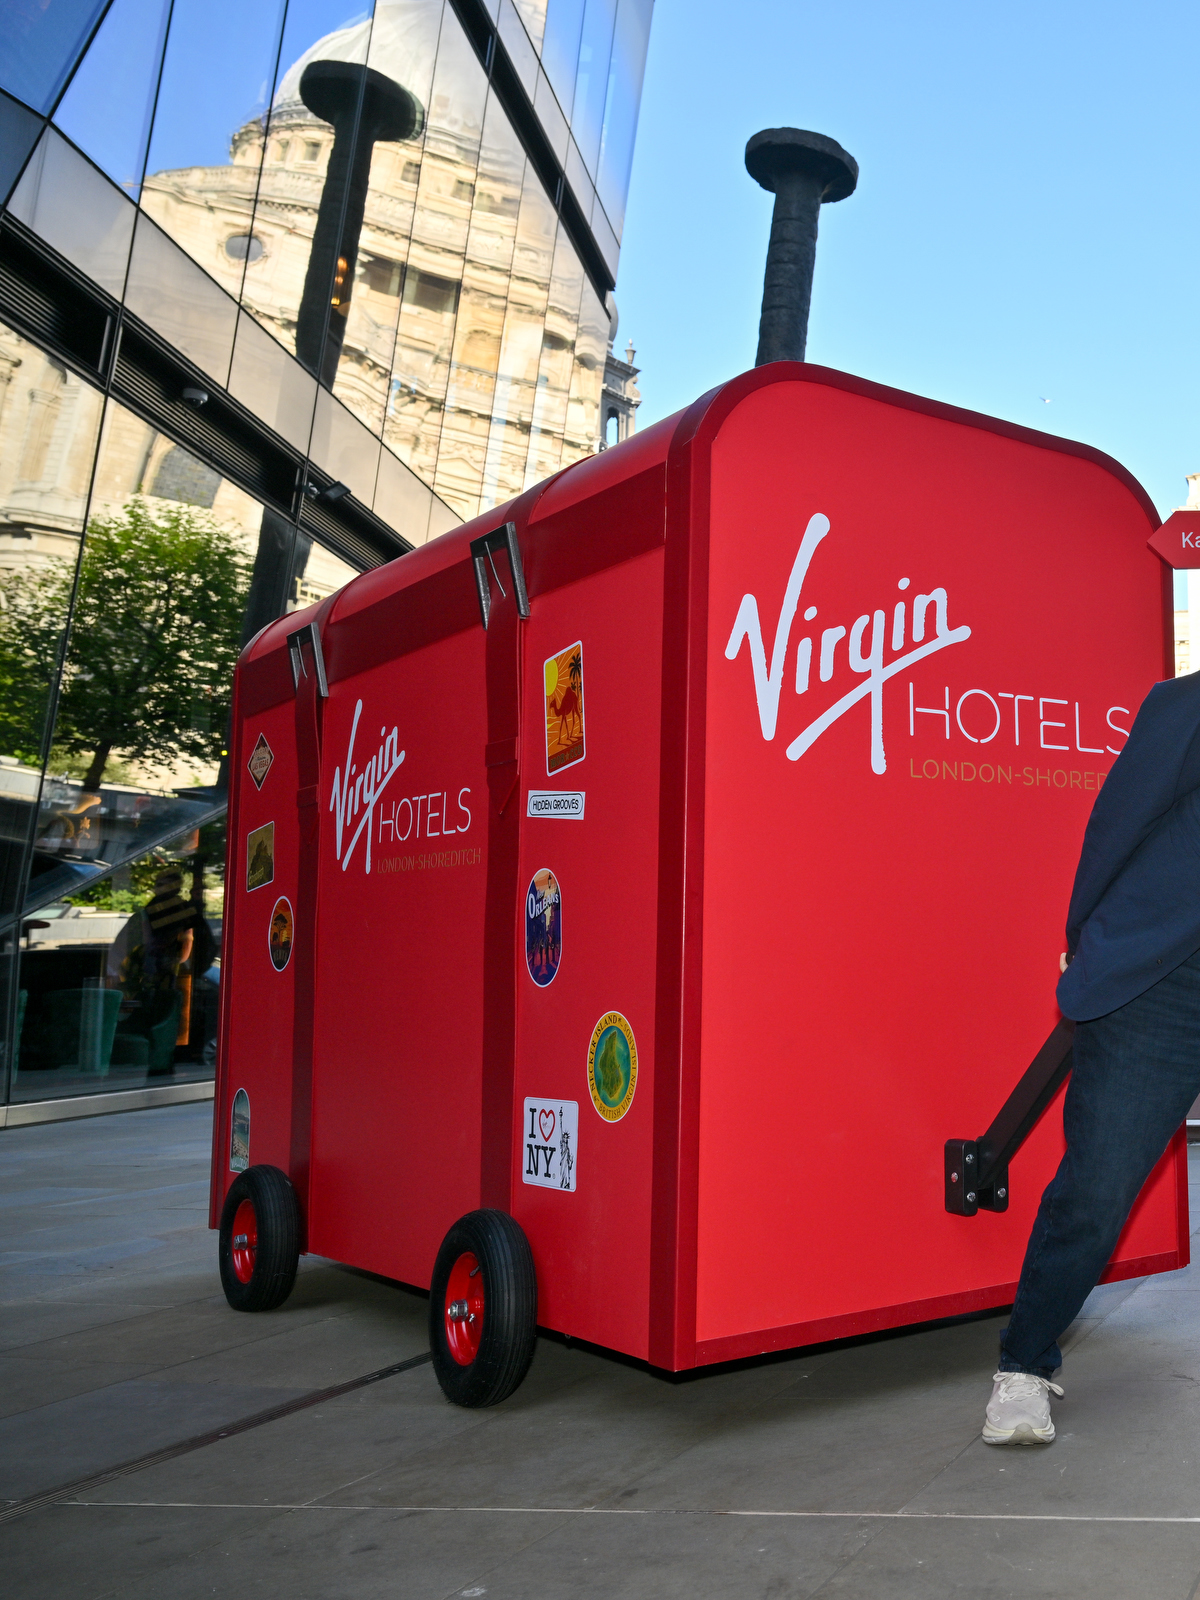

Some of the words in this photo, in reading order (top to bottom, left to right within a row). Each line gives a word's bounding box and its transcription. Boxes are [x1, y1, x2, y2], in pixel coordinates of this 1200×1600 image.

[723, 512, 973, 775] Virgin
[908, 681, 1130, 756] HOTELS
[329, 698, 406, 874] Virgin
[532, 799, 552, 811] HIDDEN
[552, 798, 579, 810] GROOVES
[378, 786, 472, 844] HOTELS
[377, 847, 482, 874] LONDON-SHOREDITCH
[528, 892, 560, 919] ORLEANS
[588, 1040, 597, 1091] NECKER
[595, 1014, 618, 1038] ISLAND
[598, 1103, 621, 1119] BRITISH
[621, 1074, 636, 1111] VIRGIN
[529, 1107, 537, 1139] I
[526, 1143, 556, 1178] NY
